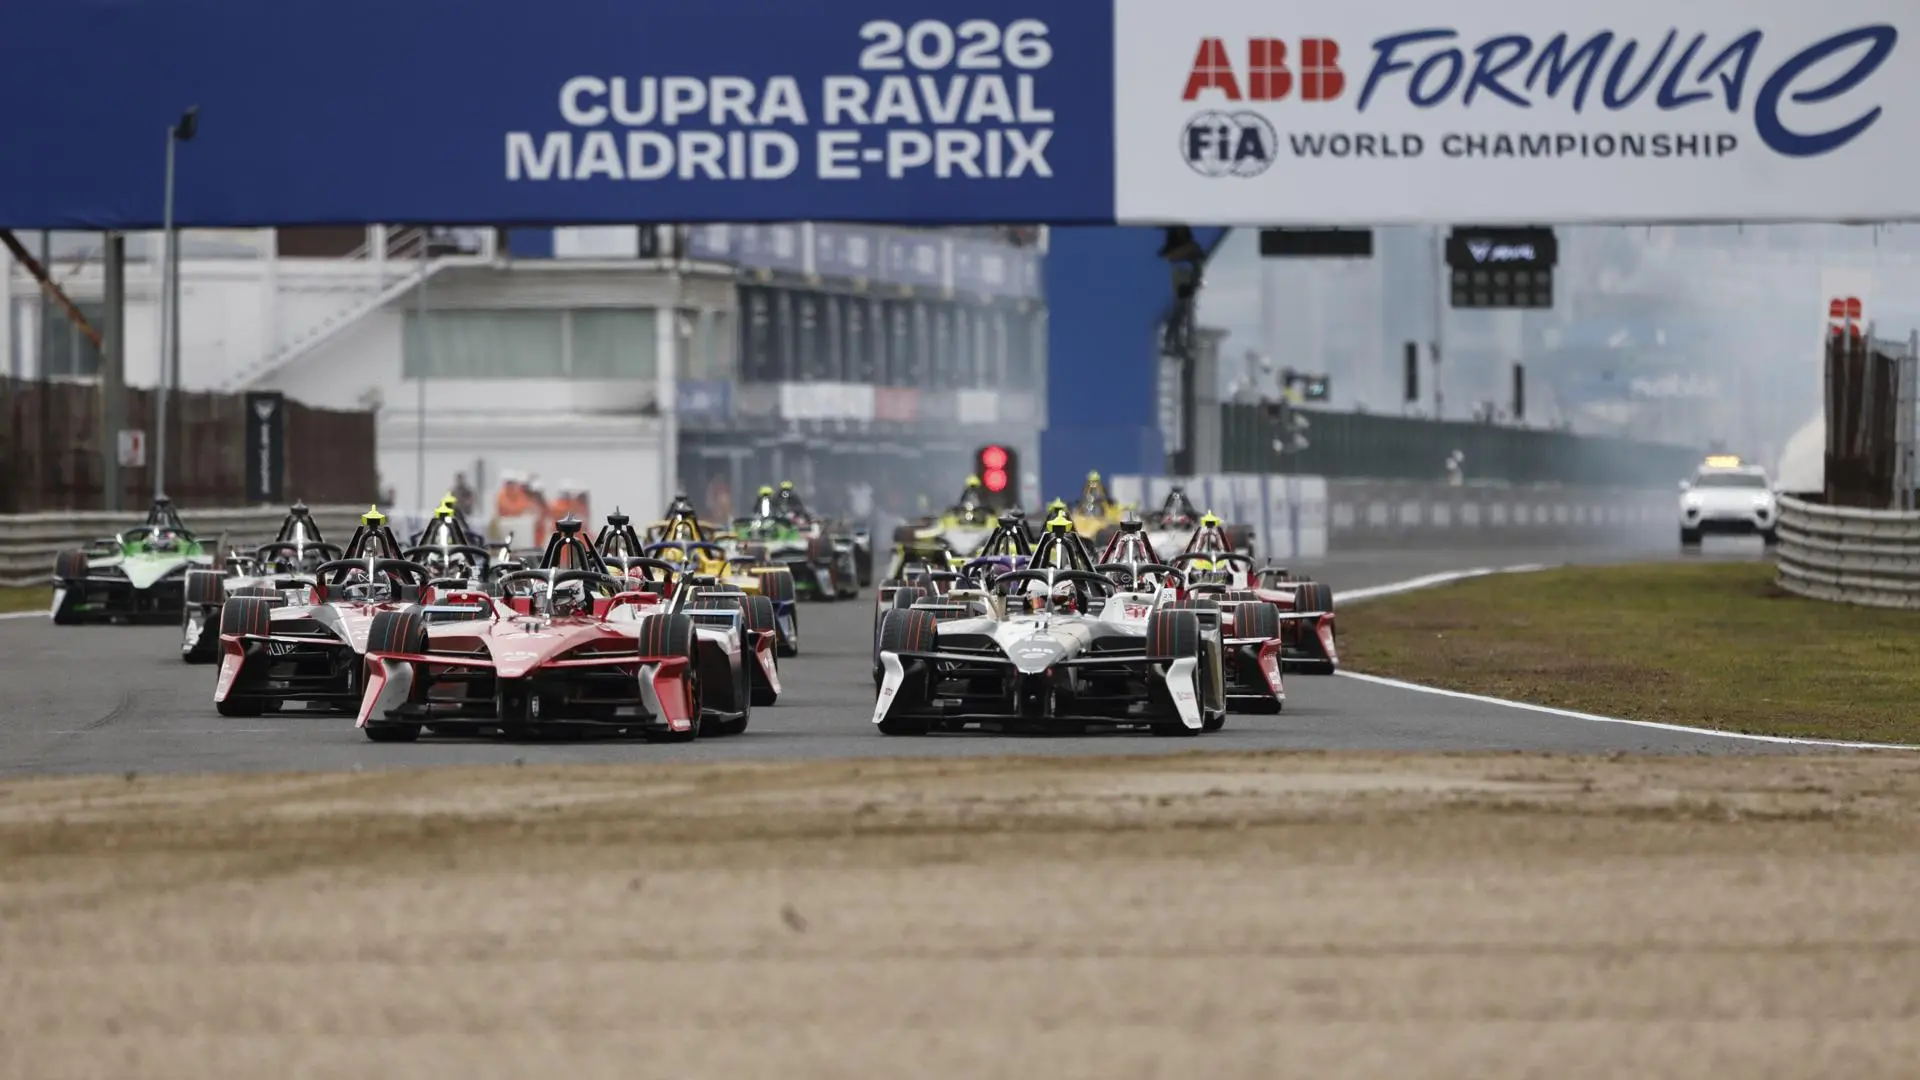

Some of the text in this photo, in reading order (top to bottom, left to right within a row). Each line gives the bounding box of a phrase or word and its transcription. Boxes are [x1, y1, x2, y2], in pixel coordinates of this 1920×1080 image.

[860, 19, 1053, 69] 2026
[1183, 38, 1345, 101] ABB
[1357, 27, 1765, 114] FORMULA
[560, 75, 1054, 126] CUPRA RAVAL
[506, 129, 1053, 180] MADRID E-PRIX
[1288, 132, 1740, 158] WORLD CHAMPIONSHIP
